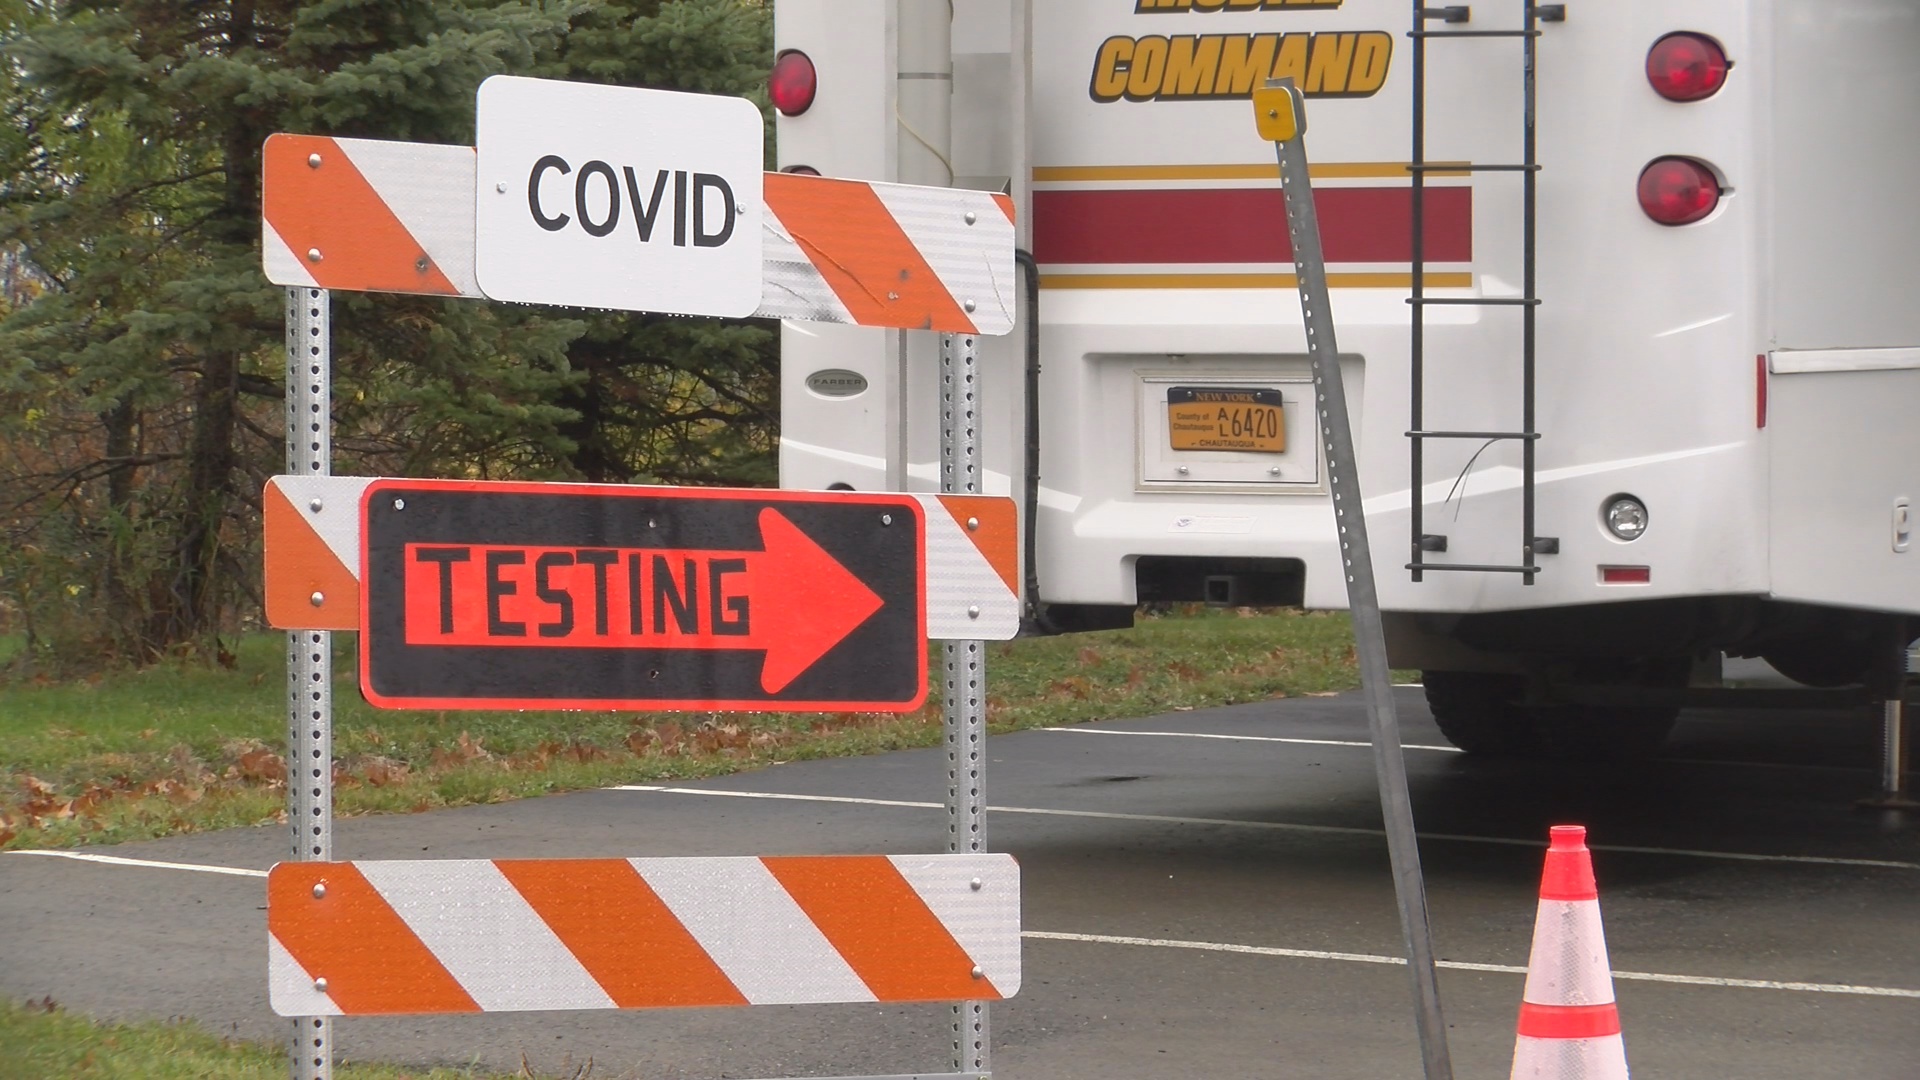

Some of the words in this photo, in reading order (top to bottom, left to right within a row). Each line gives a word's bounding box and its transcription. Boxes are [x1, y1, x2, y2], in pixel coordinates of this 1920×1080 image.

[1090, 31, 1393, 103] COMMAND
[528, 154, 736, 248] COVID
[813, 378, 862, 386] FARBER
[1196, 392, 1223, 402] NEW
[1225, 393, 1255, 403] YORK
[1176, 412, 1200, 422] County
[1173, 422, 1214, 432] Chautauqua
[1199, 439, 1256, 448] CHAUTAUQUA
[415, 546, 750, 638] TESTING
